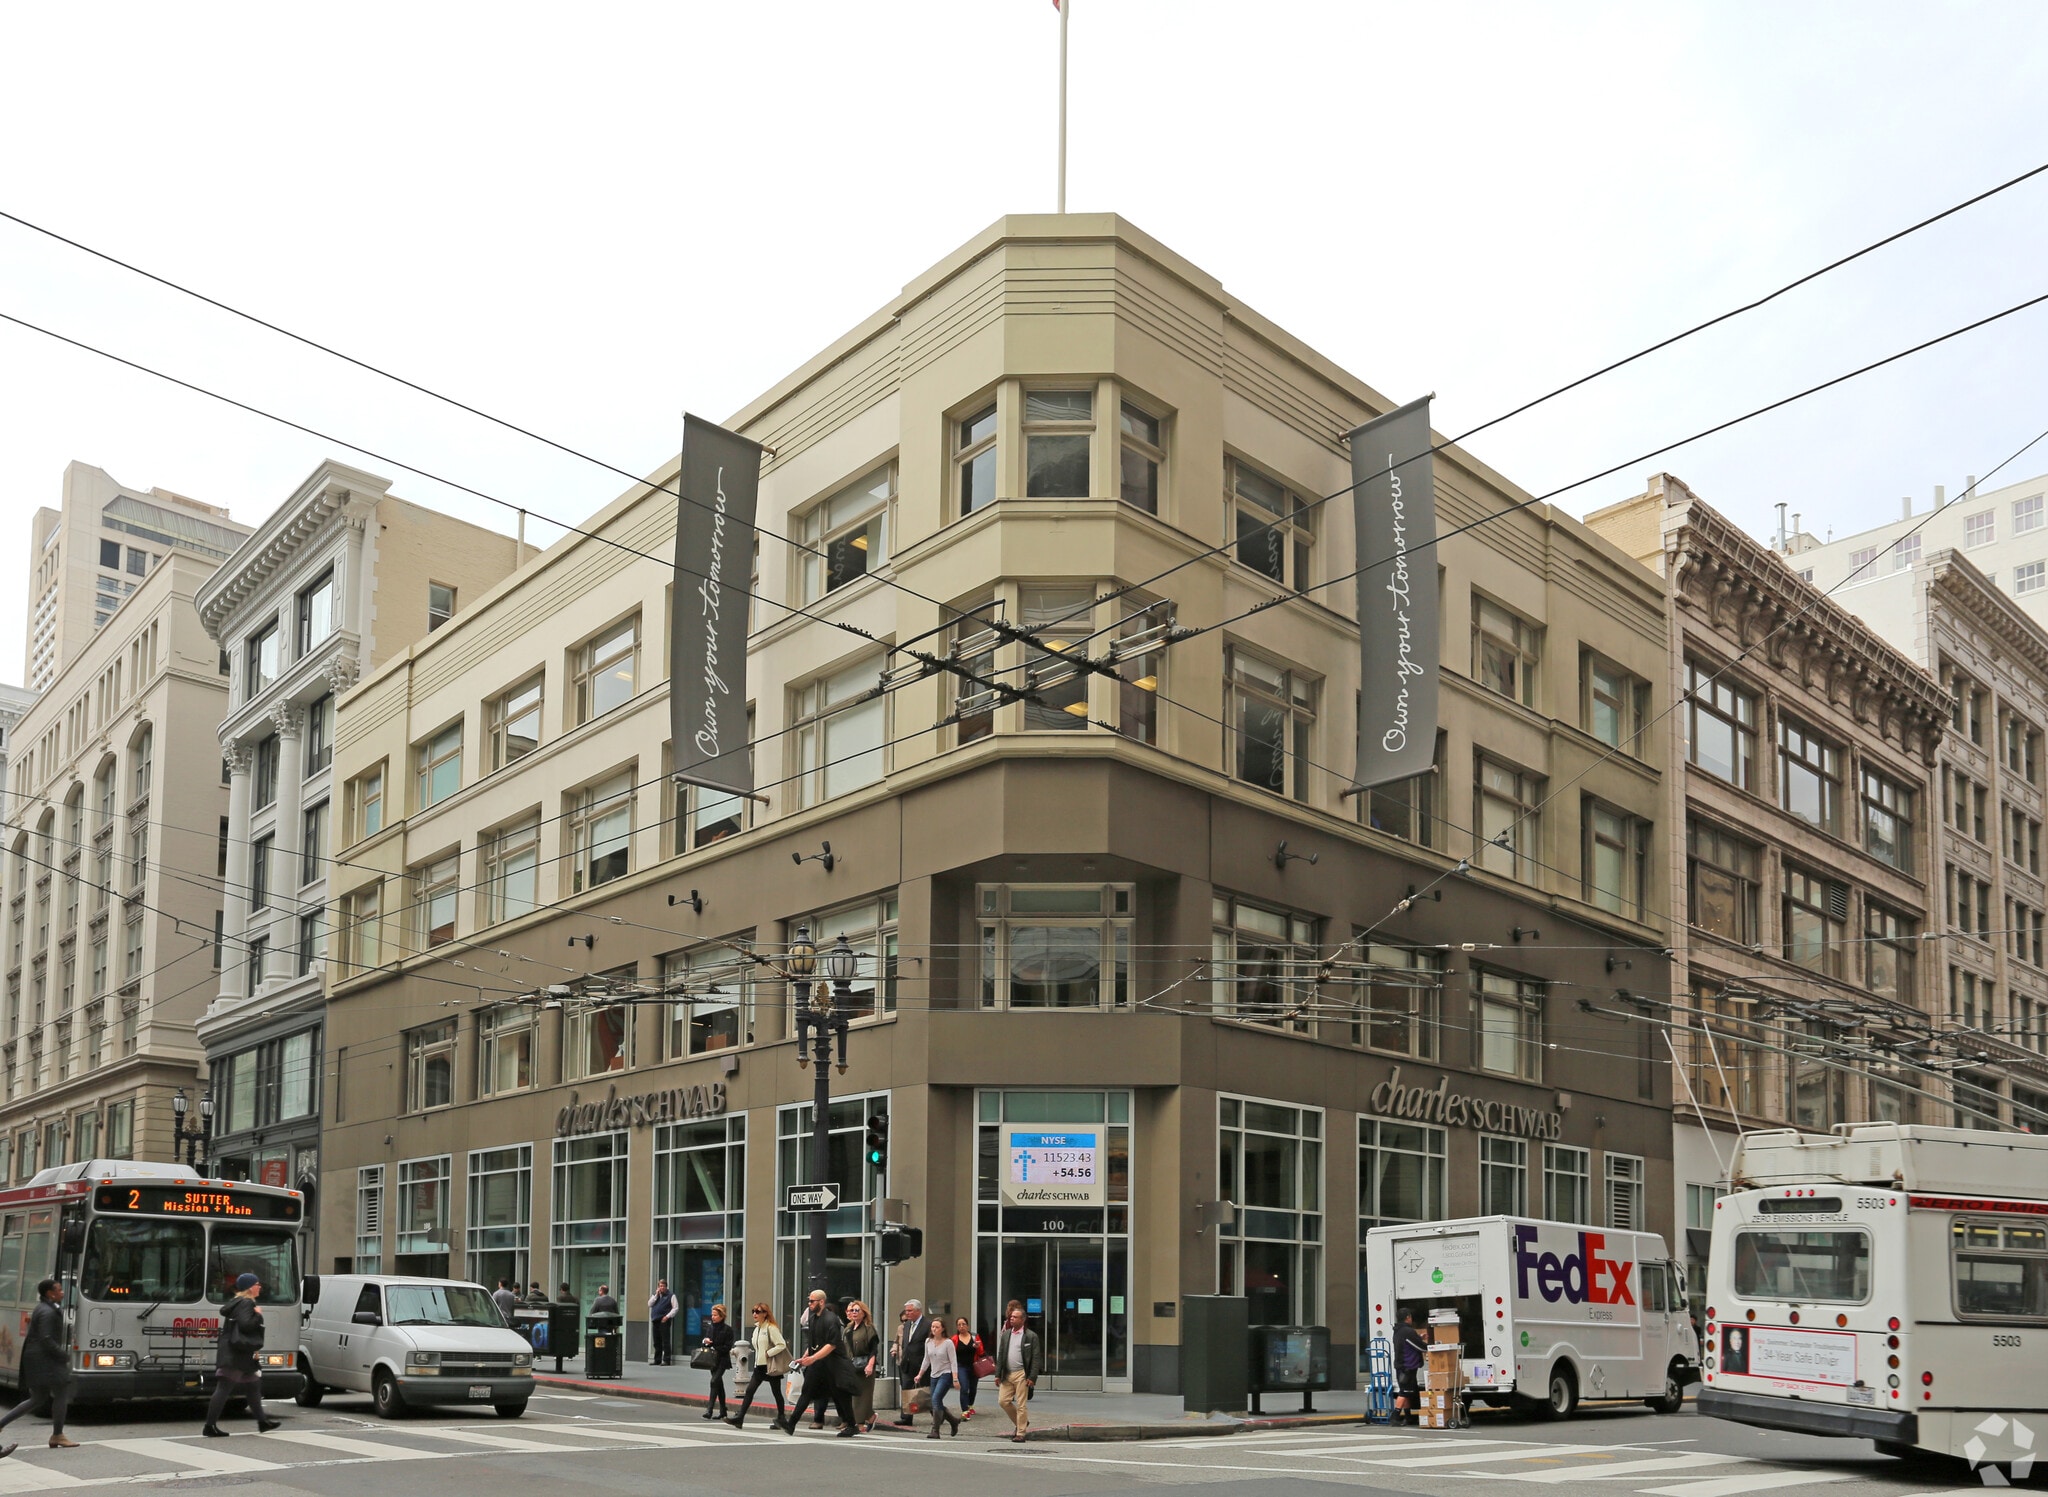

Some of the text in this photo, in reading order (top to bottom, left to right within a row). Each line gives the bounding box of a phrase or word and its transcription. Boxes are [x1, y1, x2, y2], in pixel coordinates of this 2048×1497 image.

[1382, 453, 1424, 753] Own your tomorrow
[694, 466, 730, 758] Own your tomorrow
[1041, 1136, 1067, 1145] NYSE
[1043, 1153, 1092, 1163] 11523.43
[1053, 1168, 1092, 1178] +54.56
[128, 1189, 141, 1209] 2
[184, 1193, 230, 1205] SUTTER
[792, 1192, 823, 1204] ONE WAY
[1857, 1198, 1885, 1209] 5503
[1915, 1198, 1984, 1210] ZERO
[164, 1201, 209, 1213] Mission
[226, 1205, 252, 1215] Main
[1752, 1213, 1848, 1223] ZERO EMISSIONS VEHICLE
[1042, 1220, 1065, 1231] 100
[1515, 1224, 1636, 1306] FedEx
[1589, 1307, 1614, 1320] Express
[89, 1338, 123, 1349] 8438
[1993, 1335, 2021, 1347] 5503
[1763, 1349, 1839, 1367] 34-Year Safe Driver
